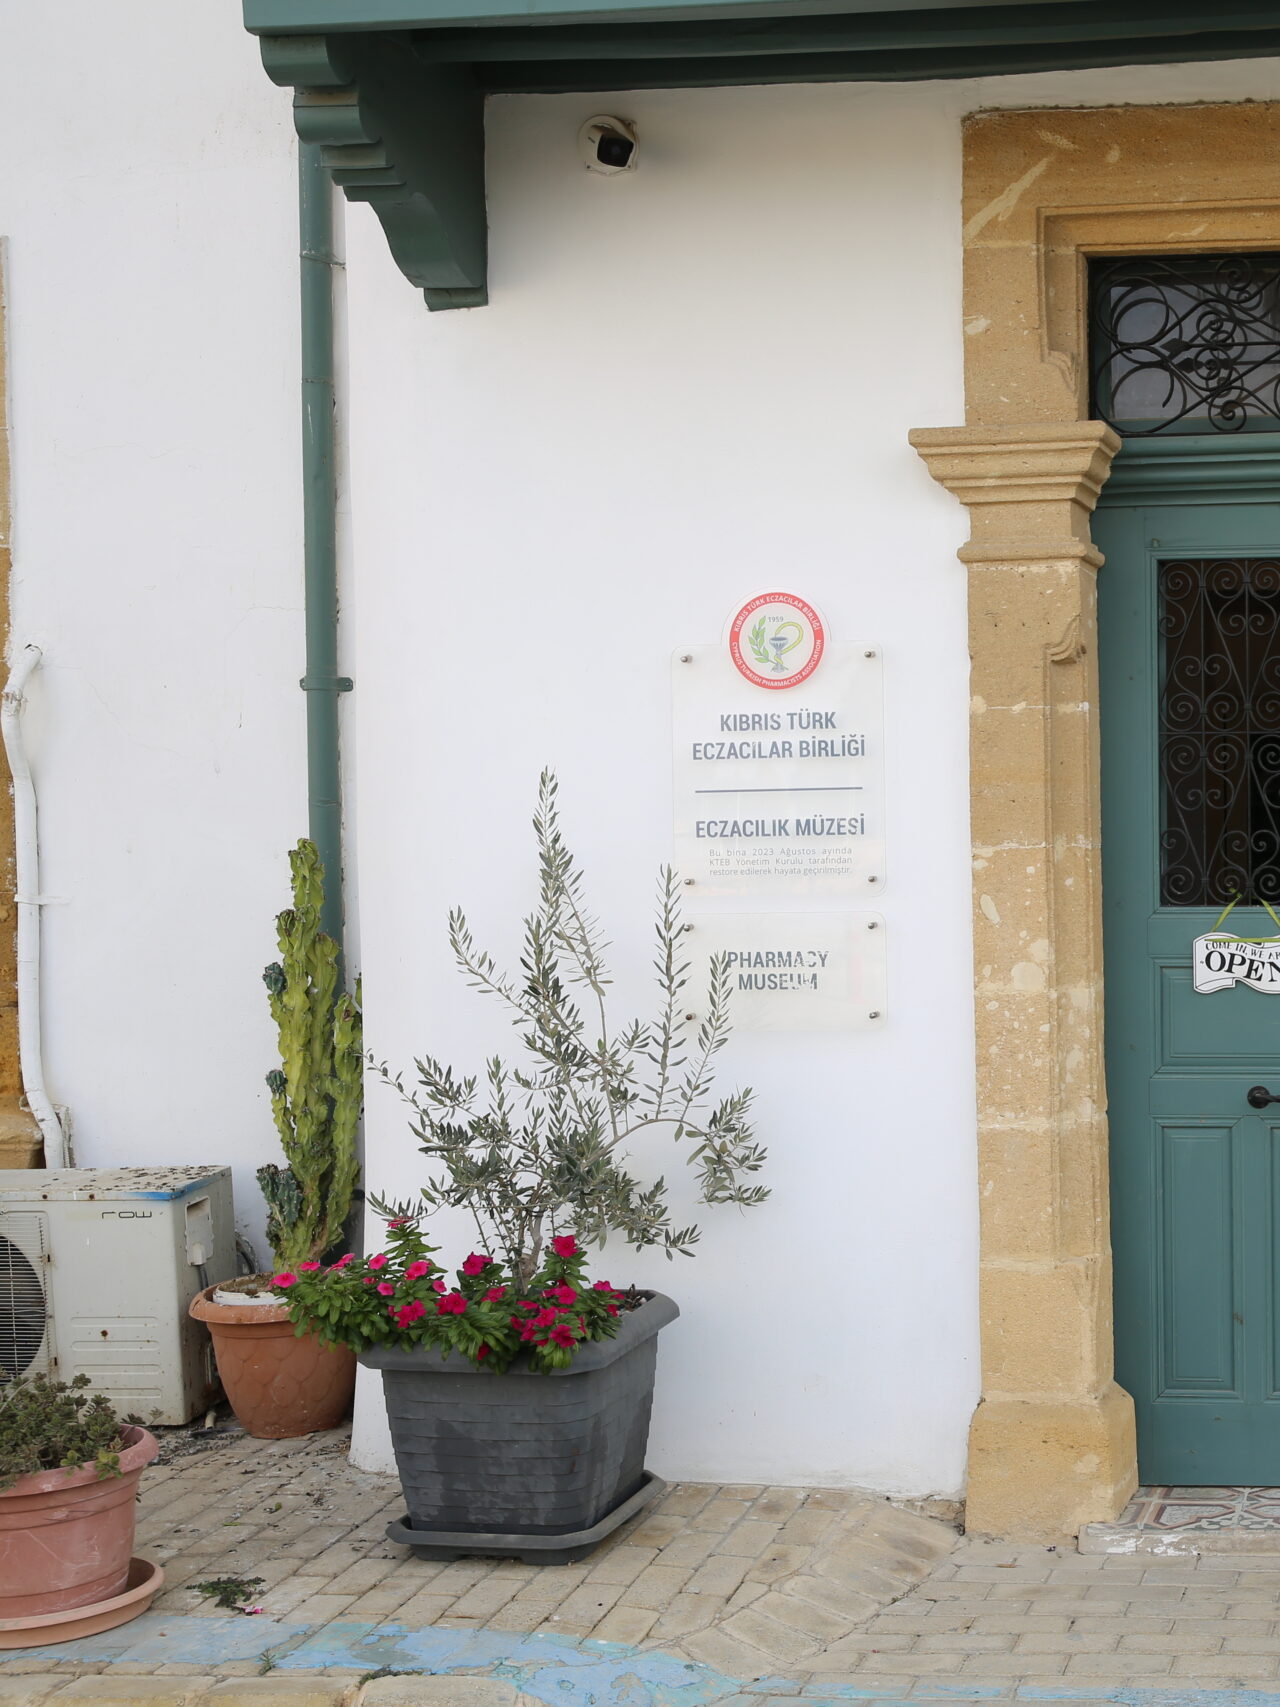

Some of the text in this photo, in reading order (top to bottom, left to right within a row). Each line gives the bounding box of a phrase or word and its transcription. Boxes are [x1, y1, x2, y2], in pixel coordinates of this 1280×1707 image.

[747, 599, 767, 611] TÜRK
[720, 708, 837, 732] KIBRIS TÜRK
[799, 734, 865, 758] BİRLİĞİ
[695, 813, 865, 838] ECZACILIK MÜZESİ
[709, 847, 852, 857] Bu bina 2023 Ağustos ayında
[709, 856, 852, 866] KTEB Yönetim Kurulu tarafından
[709, 868, 738, 876] restore
[740, 867, 771, 875] edilerek
[774, 867, 802, 876] hayata
[1205, 941, 1232, 951] COME
[1251, 949, 1265, 958] WE
[738, 973, 818, 990] MUSEUM
